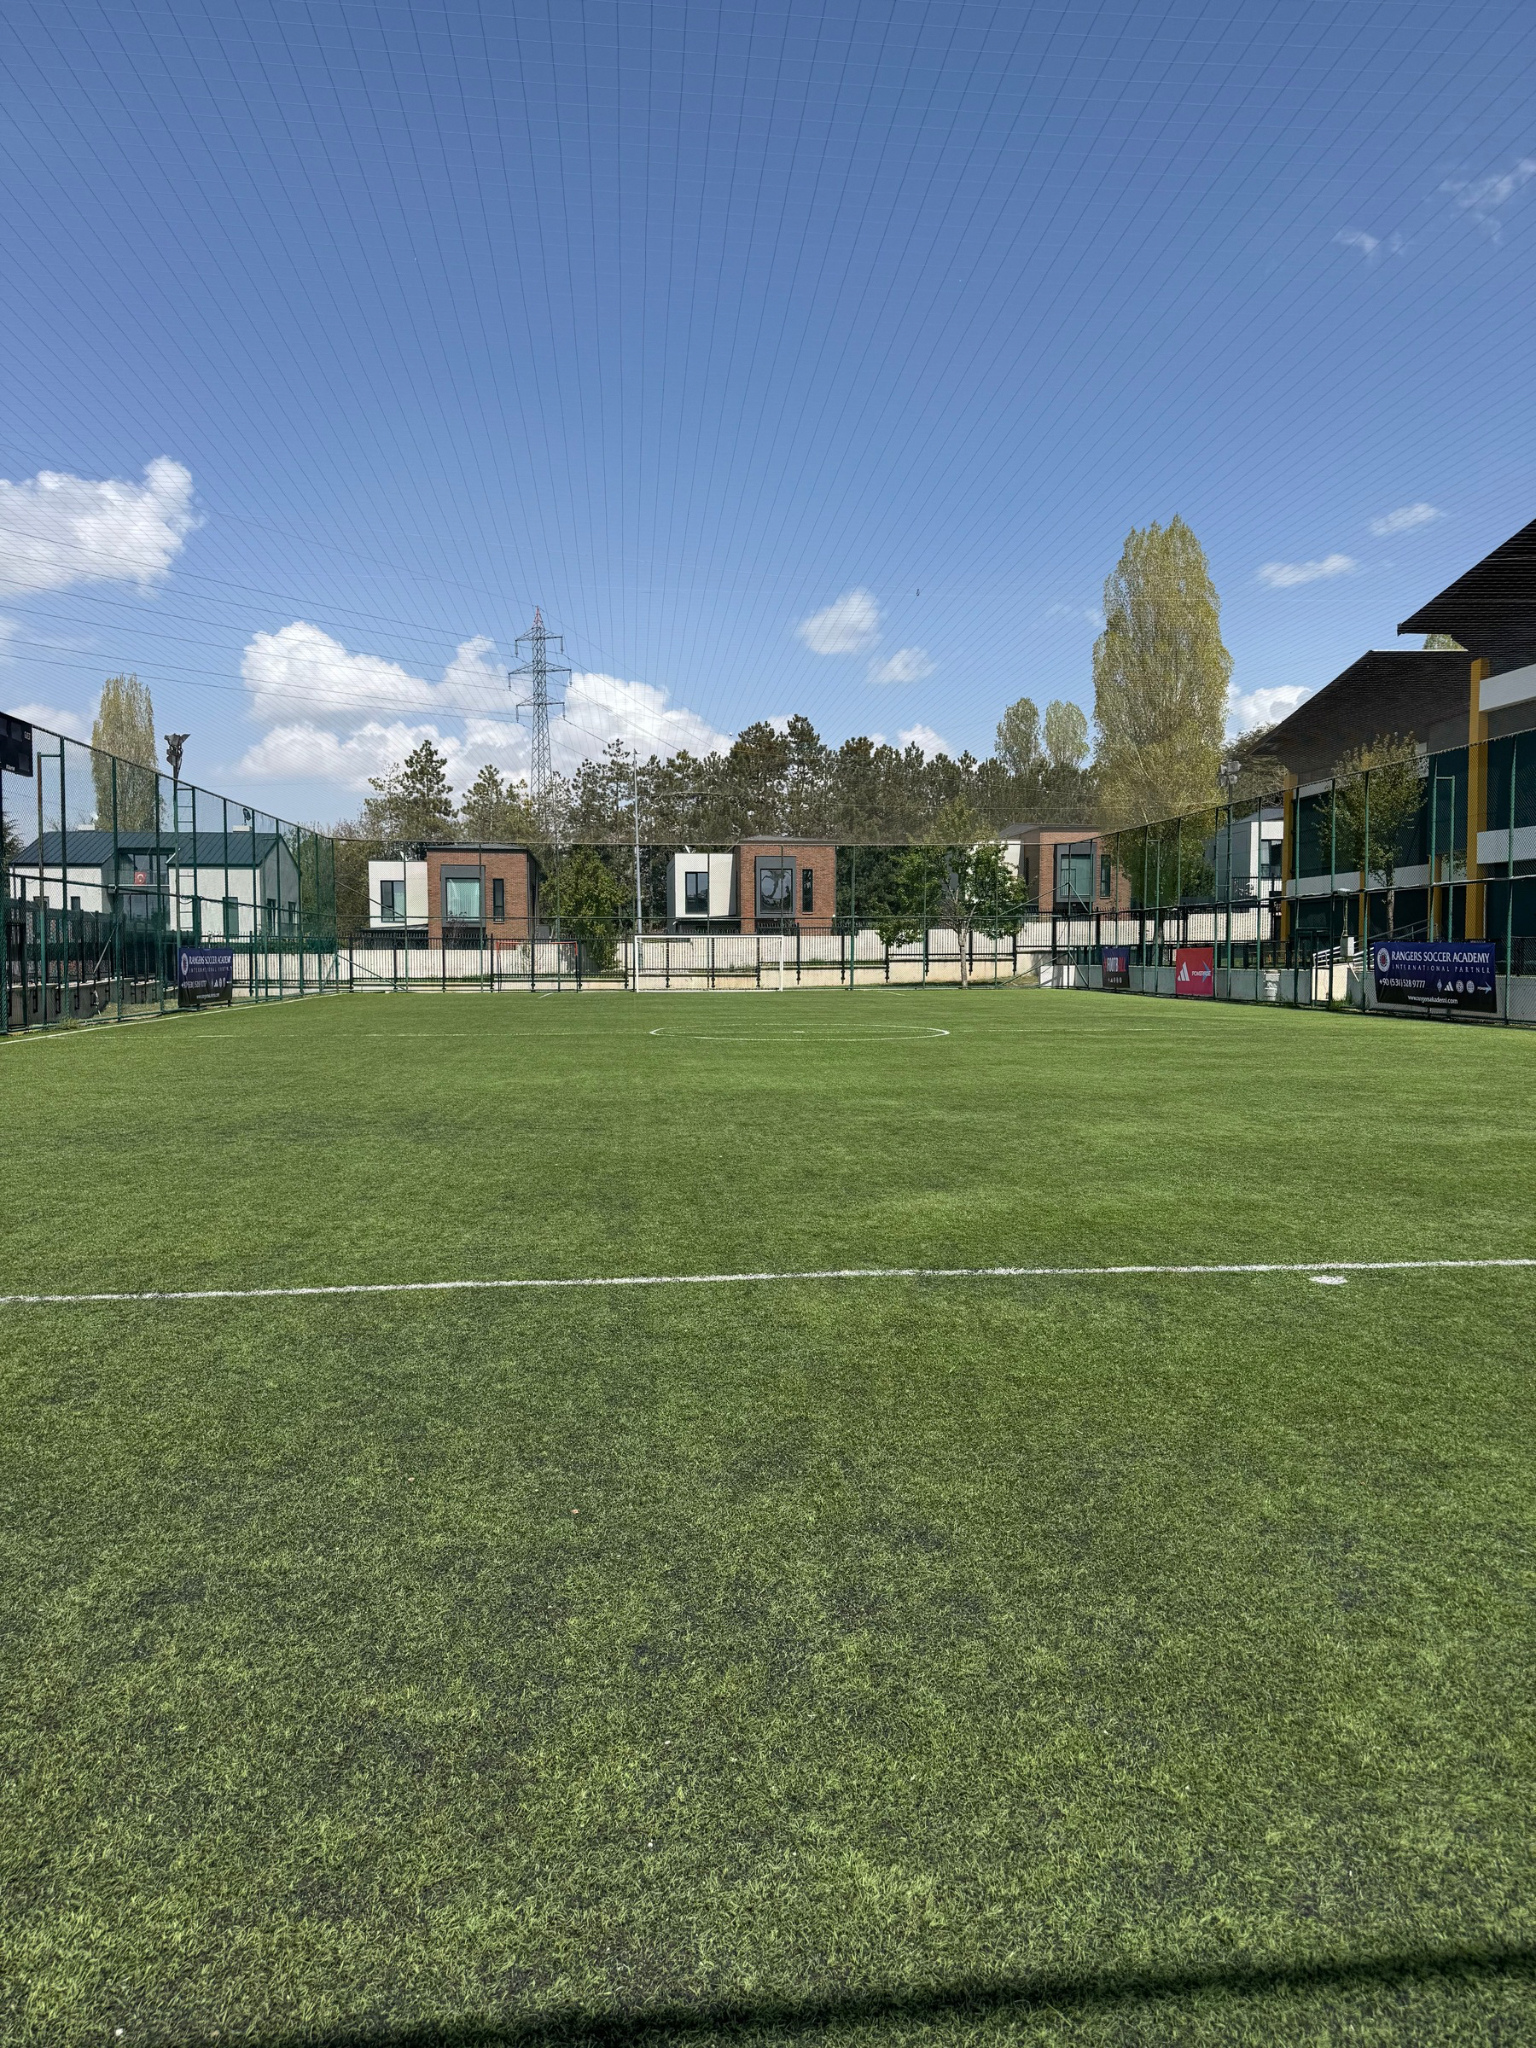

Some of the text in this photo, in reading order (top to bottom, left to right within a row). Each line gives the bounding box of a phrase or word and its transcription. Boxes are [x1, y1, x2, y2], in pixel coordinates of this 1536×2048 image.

[1391, 950, 1490, 963] RANGERS SOCCER ACADEMY
[1392, 963, 1490, 974] INTERNATIONAL PARTNER
[1412, 979, 1426, 989] 9777
